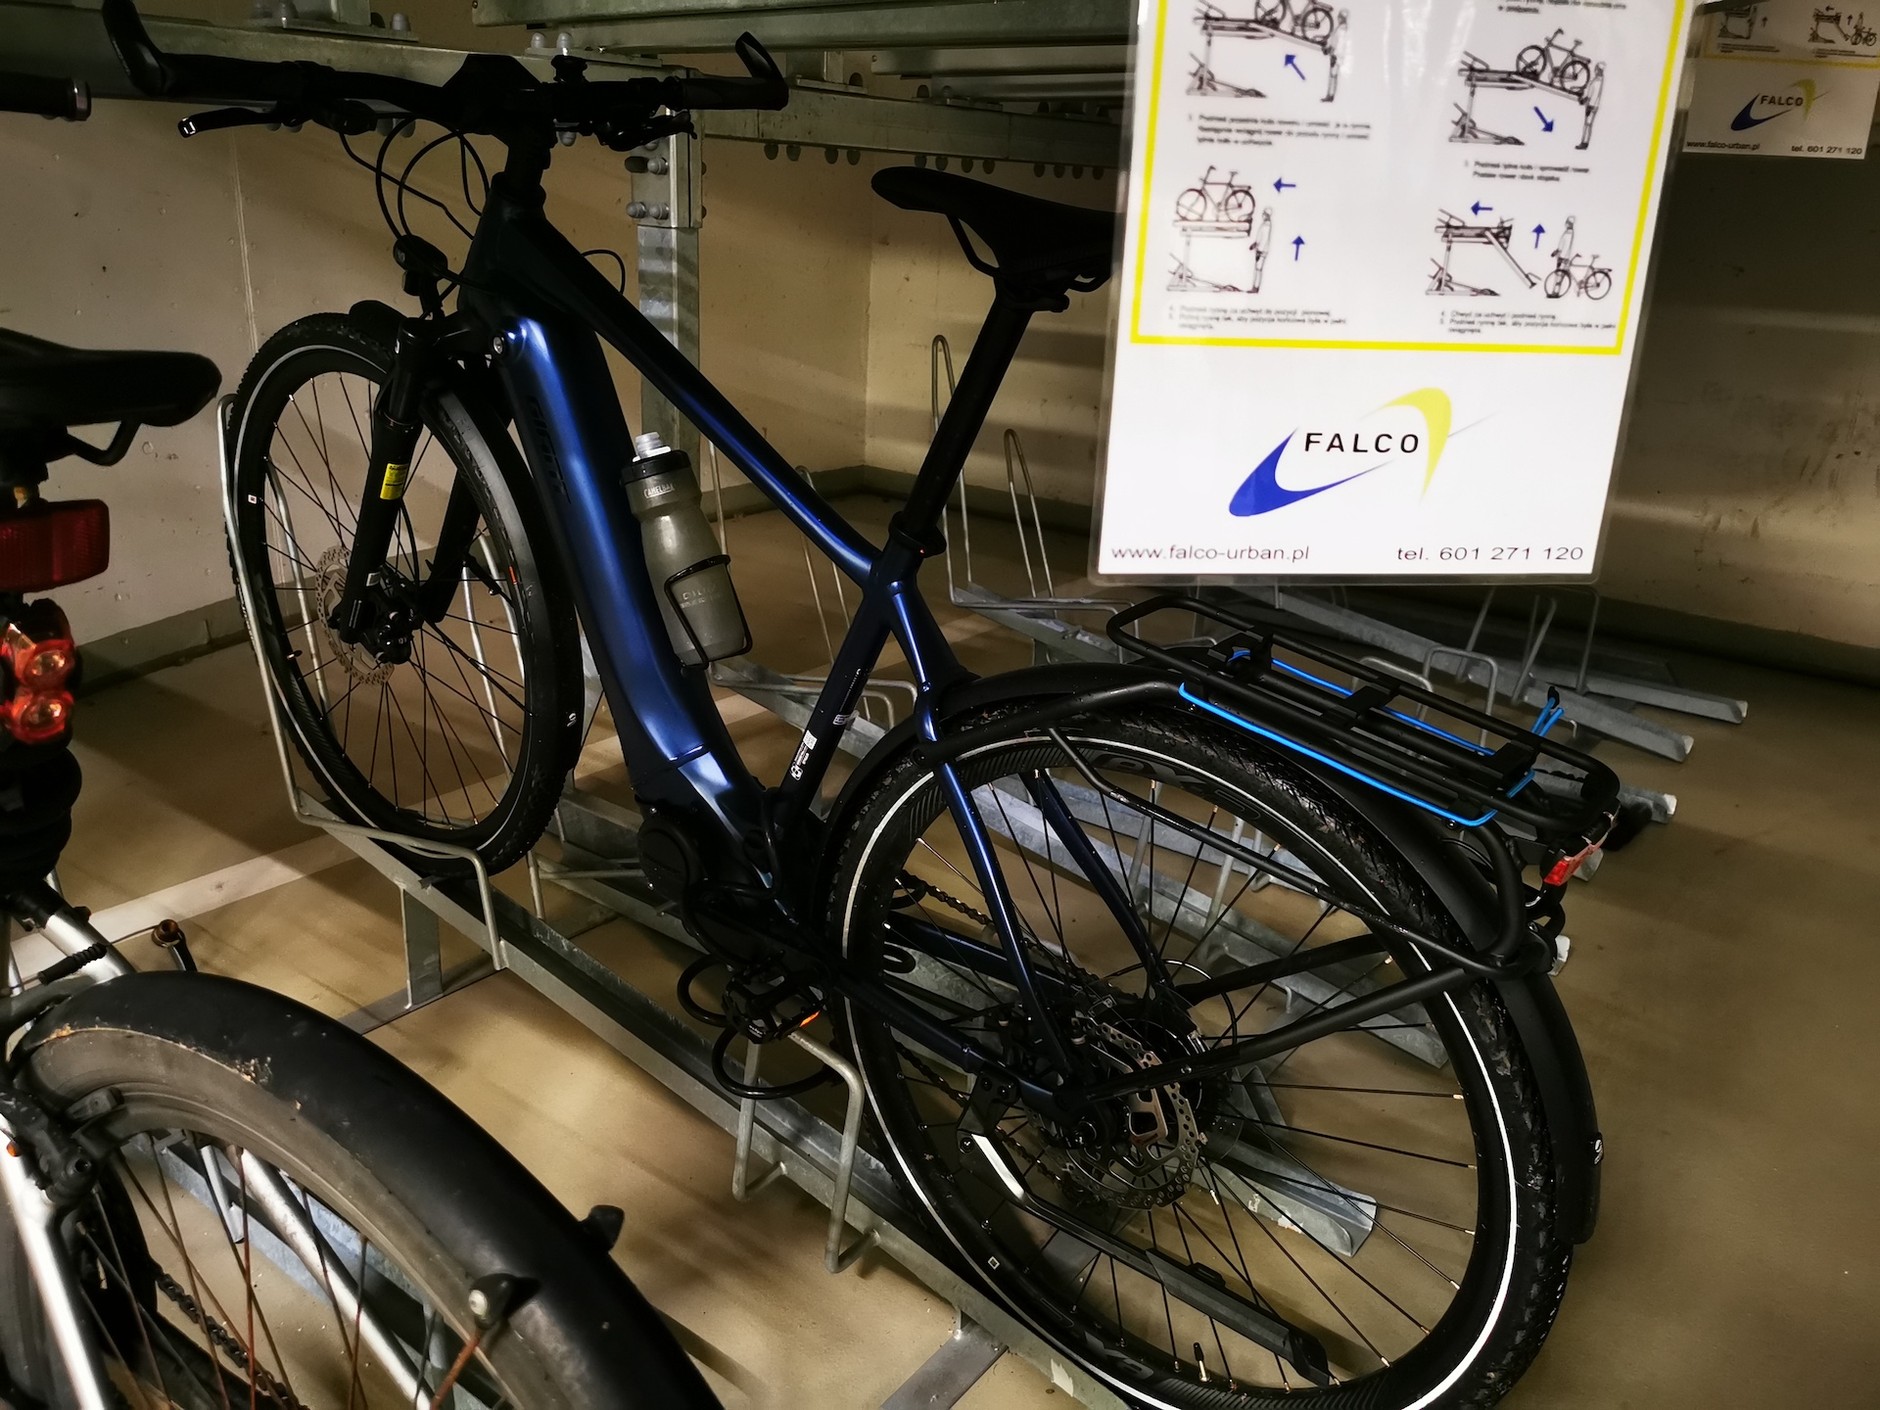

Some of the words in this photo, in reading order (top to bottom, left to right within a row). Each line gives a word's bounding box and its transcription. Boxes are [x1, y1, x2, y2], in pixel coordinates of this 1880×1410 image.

[1759, 95, 1804, 107] FALCO
[1807, 145, 1824, 153] 601
[1826, 146, 1842, 154] 271
[1847, 147, 1863, 155] 120
[1304, 432, 1420, 454] FALCO
[1111, 544, 1310, 563] www.falco-urban.pl
[1397, 546, 1430, 561] tel.
[1439, 546, 1480, 561] 601
[1490, 546, 1531, 561] 271
[1543, 546, 1584, 561] 120
